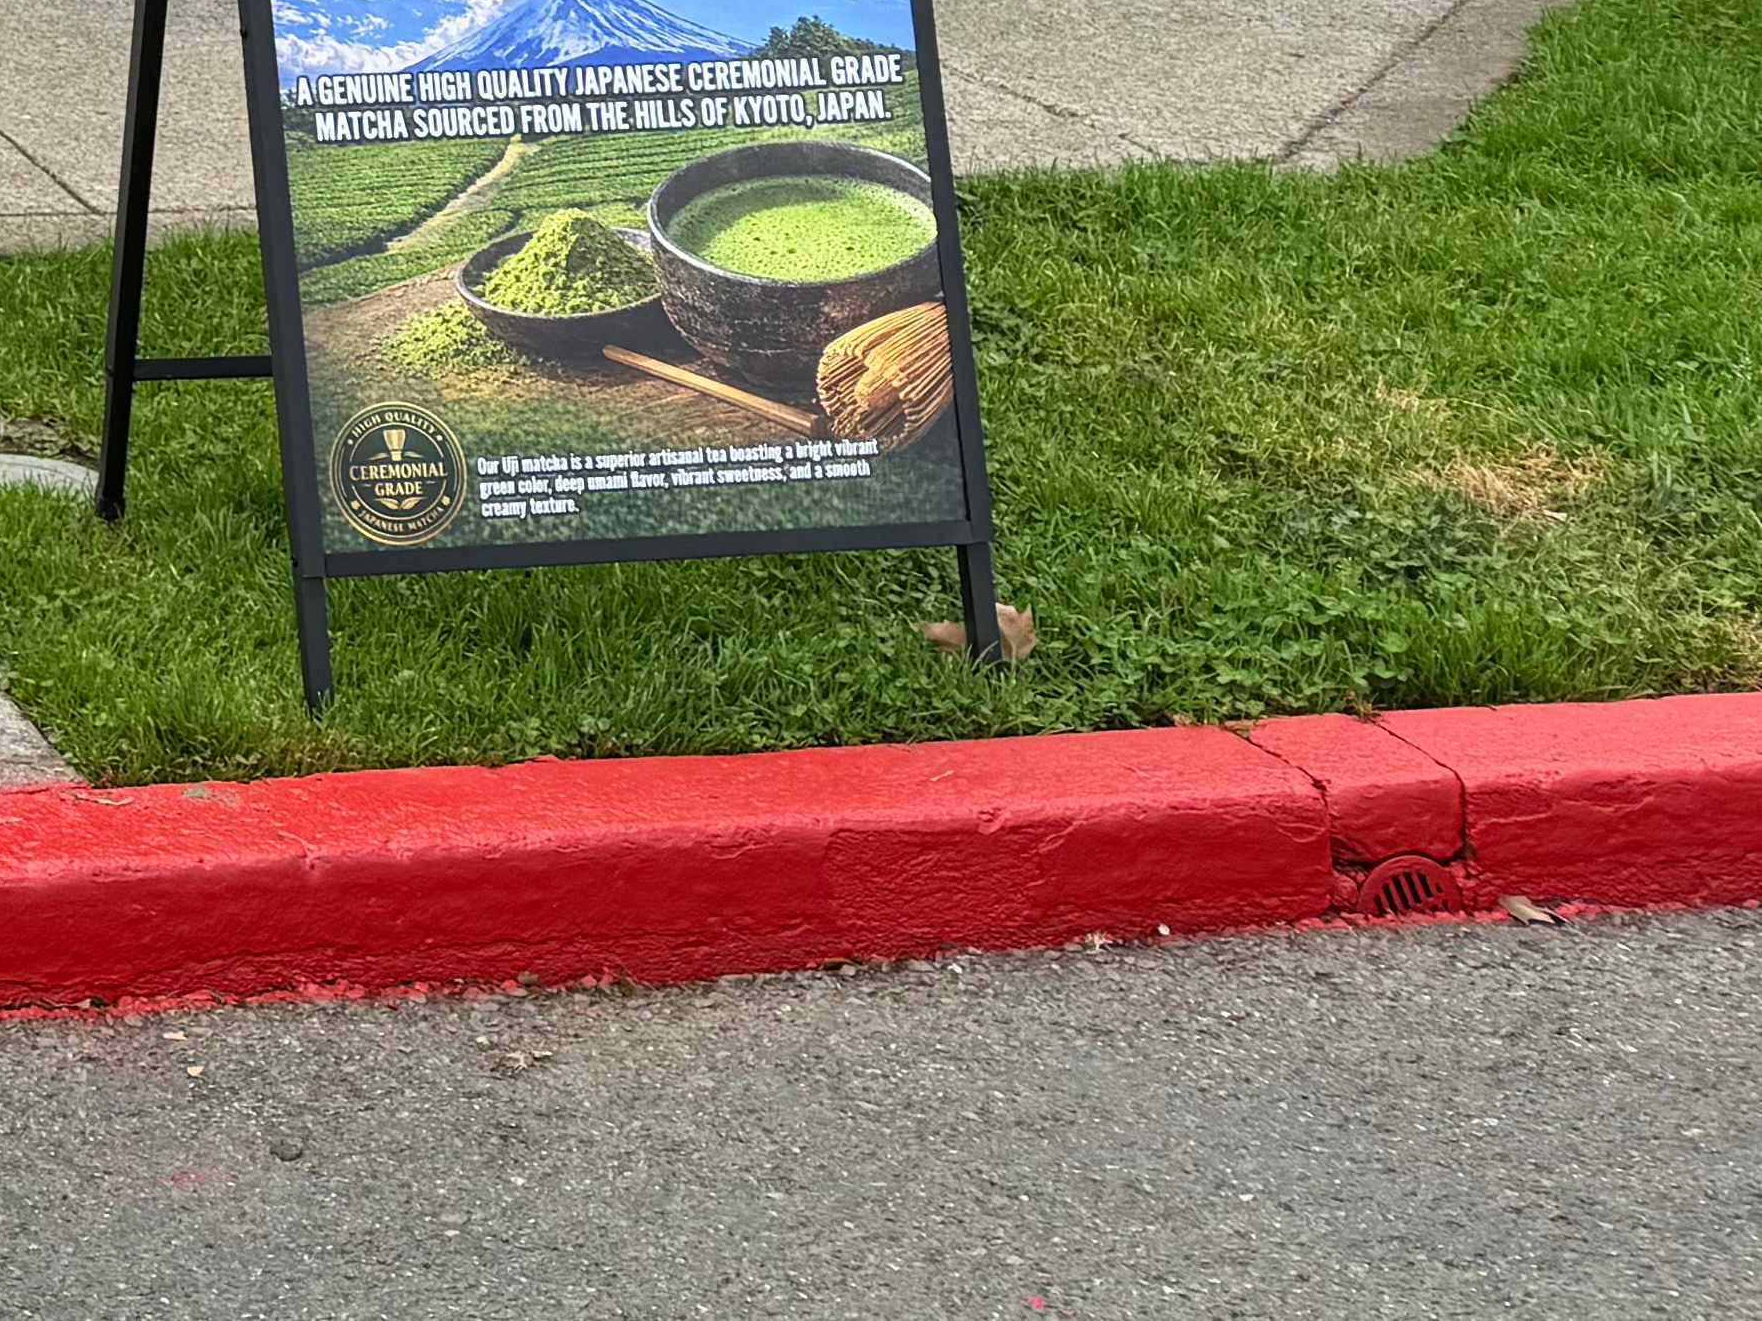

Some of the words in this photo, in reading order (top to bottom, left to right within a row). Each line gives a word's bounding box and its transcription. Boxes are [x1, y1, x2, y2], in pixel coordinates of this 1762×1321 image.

[296, 79, 315, 105] A
[317, 73, 414, 105] GENUINE
[419, 72, 473, 101] HIGH
[477, 67, 569, 99] QUALITY
[575, 63, 682, 95] JAPANESE
[687, 58, 827, 91] CEREMONIAL
[831, 54, 904, 84] GRADE
[314, 110, 408, 142] MATCHA
[413, 107, 515, 138] SOURCED
[520, 104, 583, 133] FROM
[589, 101, 629, 131] THE
[635, 98, 697, 127] HILLS
[701, 96, 730, 126] OF
[734, 93, 814, 128] KYOTO,
[817, 89, 893, 121] JAPAN.
[351, 414, 382, 438] HIGH
[384, 411, 436, 434] QUALITY
[349, 462, 448, 481] CEREMONIAL
[477, 457, 499, 476] Our
[501, 456, 519, 477] Uji
[521, 454, 568, 473] matcha
[570, 453, 582, 470] is
[584, 456, 593, 470] a
[595, 451, 646, 472] superior
[648, 447, 703, 466] artisanal
[705, 447, 727, 463] tea
[729, 443, 783, 463] boasting
[785, 445, 792, 458] a
[795, 441, 833, 462] bright
[834, 438, 879, 456] vibrant
[374, 481, 423, 496] GRADE
[479, 481, 515, 500] green
[517, 478, 553, 496] color,
[555, 475, 585, 495] deep
[587, 473, 627, 491] umami
[630, 470, 668, 489] flavor,
[671, 468, 716, 487] vibrant
[717, 466, 788, 483] sweetness,
[789, 462, 811, 480] and
[814, 465, 823, 479] a
[825, 459, 871, 478] smooth
[357, 509, 404, 533] JAPANESE
[407, 505, 445, 531] MATCHA
[481, 500, 527, 519] creamy
[529, 497, 580, 515] texture.
